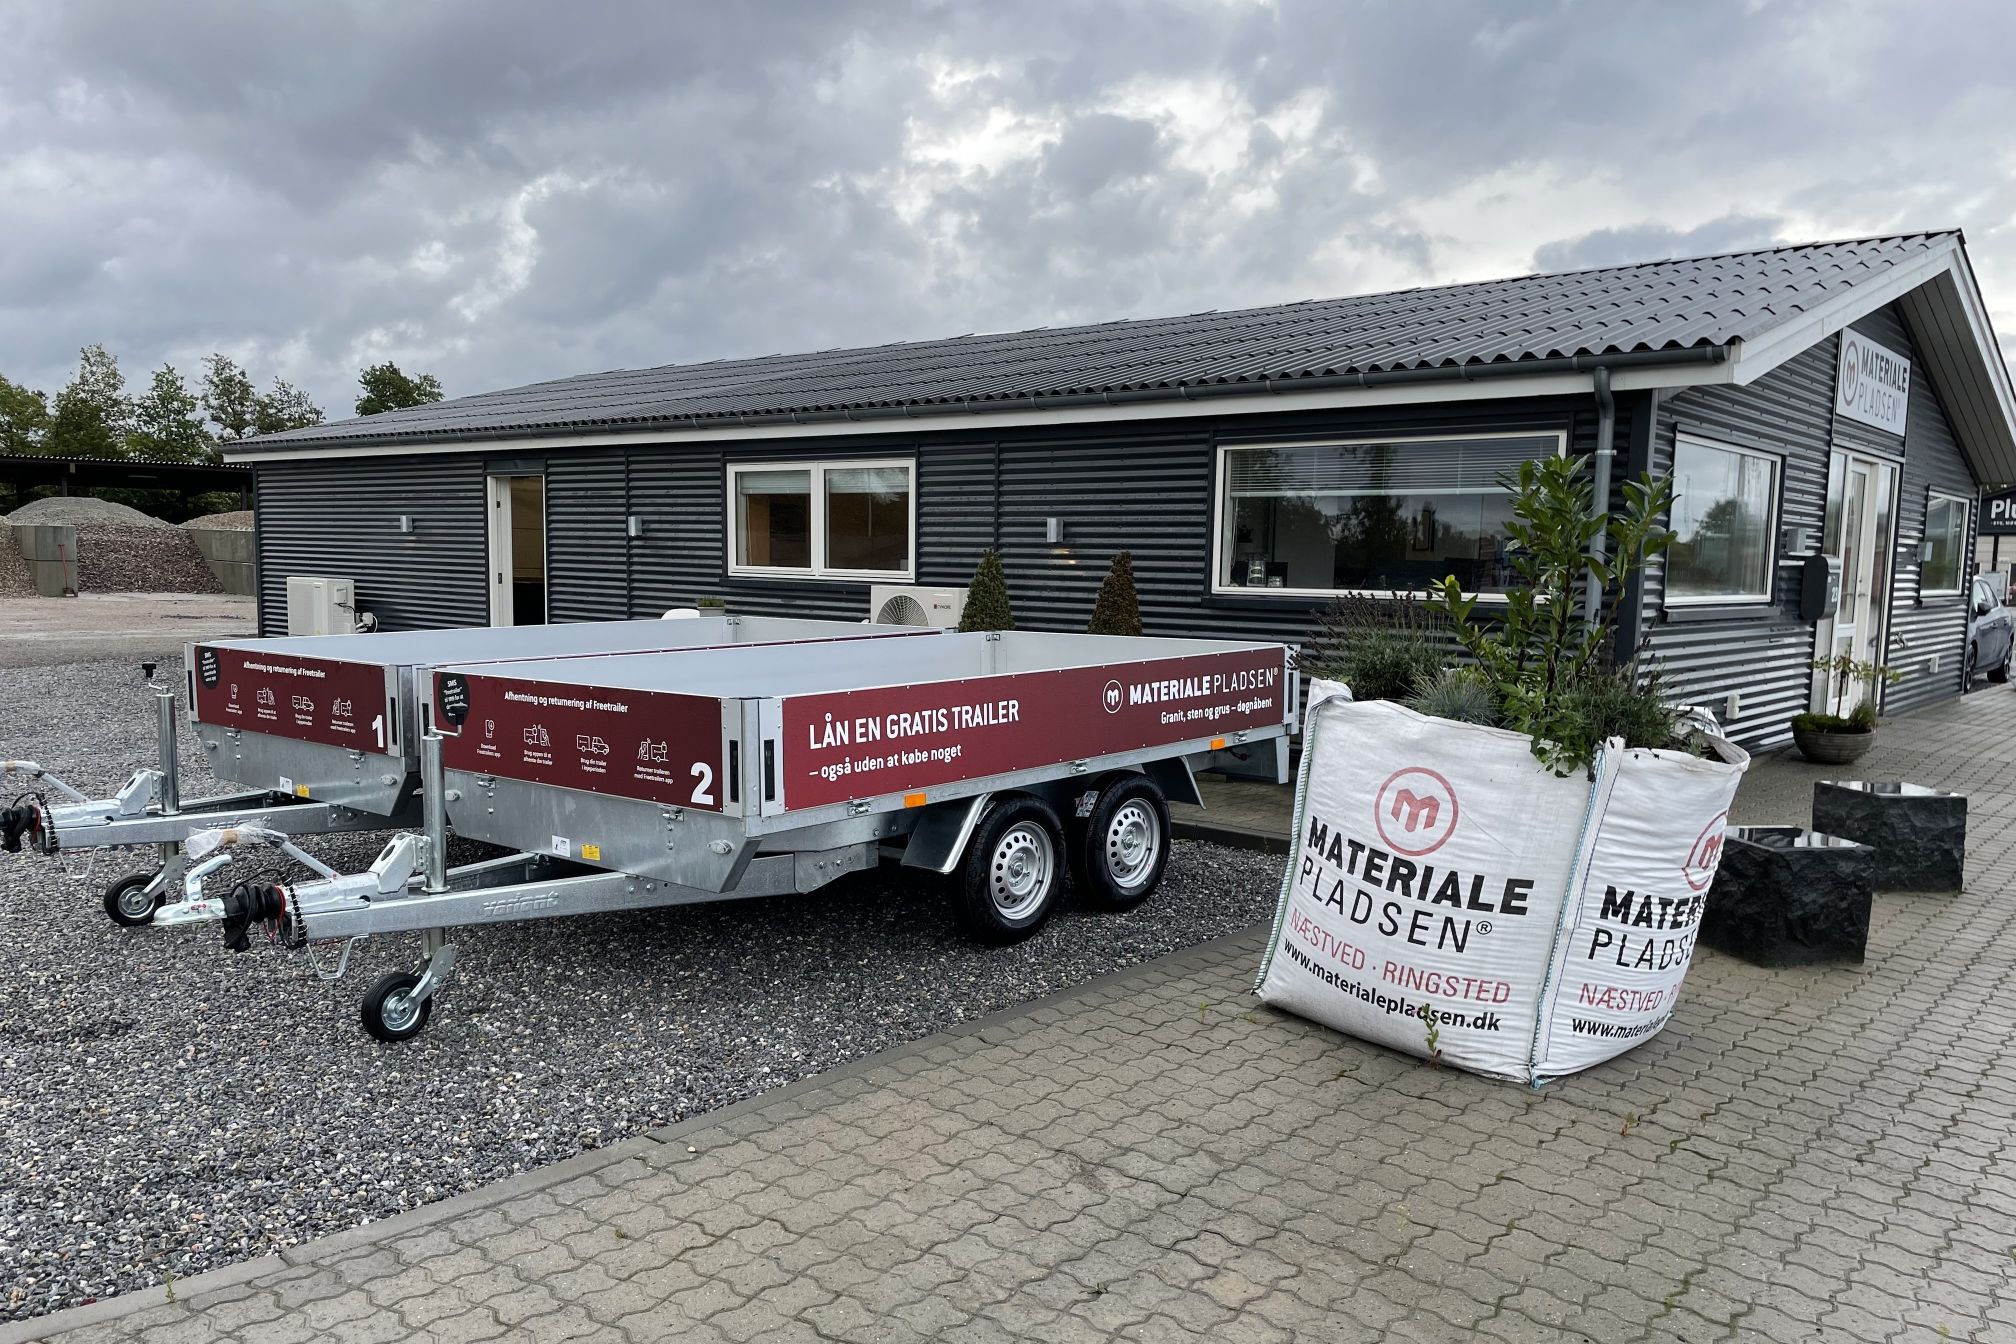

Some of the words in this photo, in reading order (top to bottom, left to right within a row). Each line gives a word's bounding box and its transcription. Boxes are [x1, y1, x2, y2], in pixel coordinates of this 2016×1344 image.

[1861, 345, 1908, 394] MATERIALE
[243, 660, 267, 674] Afhentning
[272, 665, 297, 677] returnering
[302, 668, 326, 679] Freetrailer
[504, 691, 538, 706] Afhentning
[538, 696, 548, 707] og
[548, 698, 585, 711] returnering
[585, 699, 593, 709] af
[593, 700, 629, 713] Freetrailer
[1129, 675, 1211, 706] MATERIALE
[809, 712, 849, 750] LÅN
[855, 716, 881, 744] EN
[886, 708, 949, 740] GRATIS
[951, 699, 1020, 730] TRAILER
[1161, 710, 1186, 724] Granit,
[1186, 707, 1204, 720] sten
[1204, 708, 1214, 721] og
[1214, 706, 1230, 719] grus
[1237, 696, 1273, 715] døgnåbent
[372, 714, 384, 748] 1
[821, 757, 852, 782] også
[854, 755, 884, 773] uden
[886, 753, 899, 767] at
[901, 750, 929, 766] købe
[930, 744, 962, 764] noget
[690, 761, 714, 805] 2
[1307, 815, 1535, 916] MATERIALE
[1290, 907, 1366, 972] NÆSTVED
[1382, 960, 1511, 1004] RINGSTED
[1284, 938, 1502, 1032] www.materialepladsen.dk
[1578, 983, 1664, 1012] NÆSTVED
